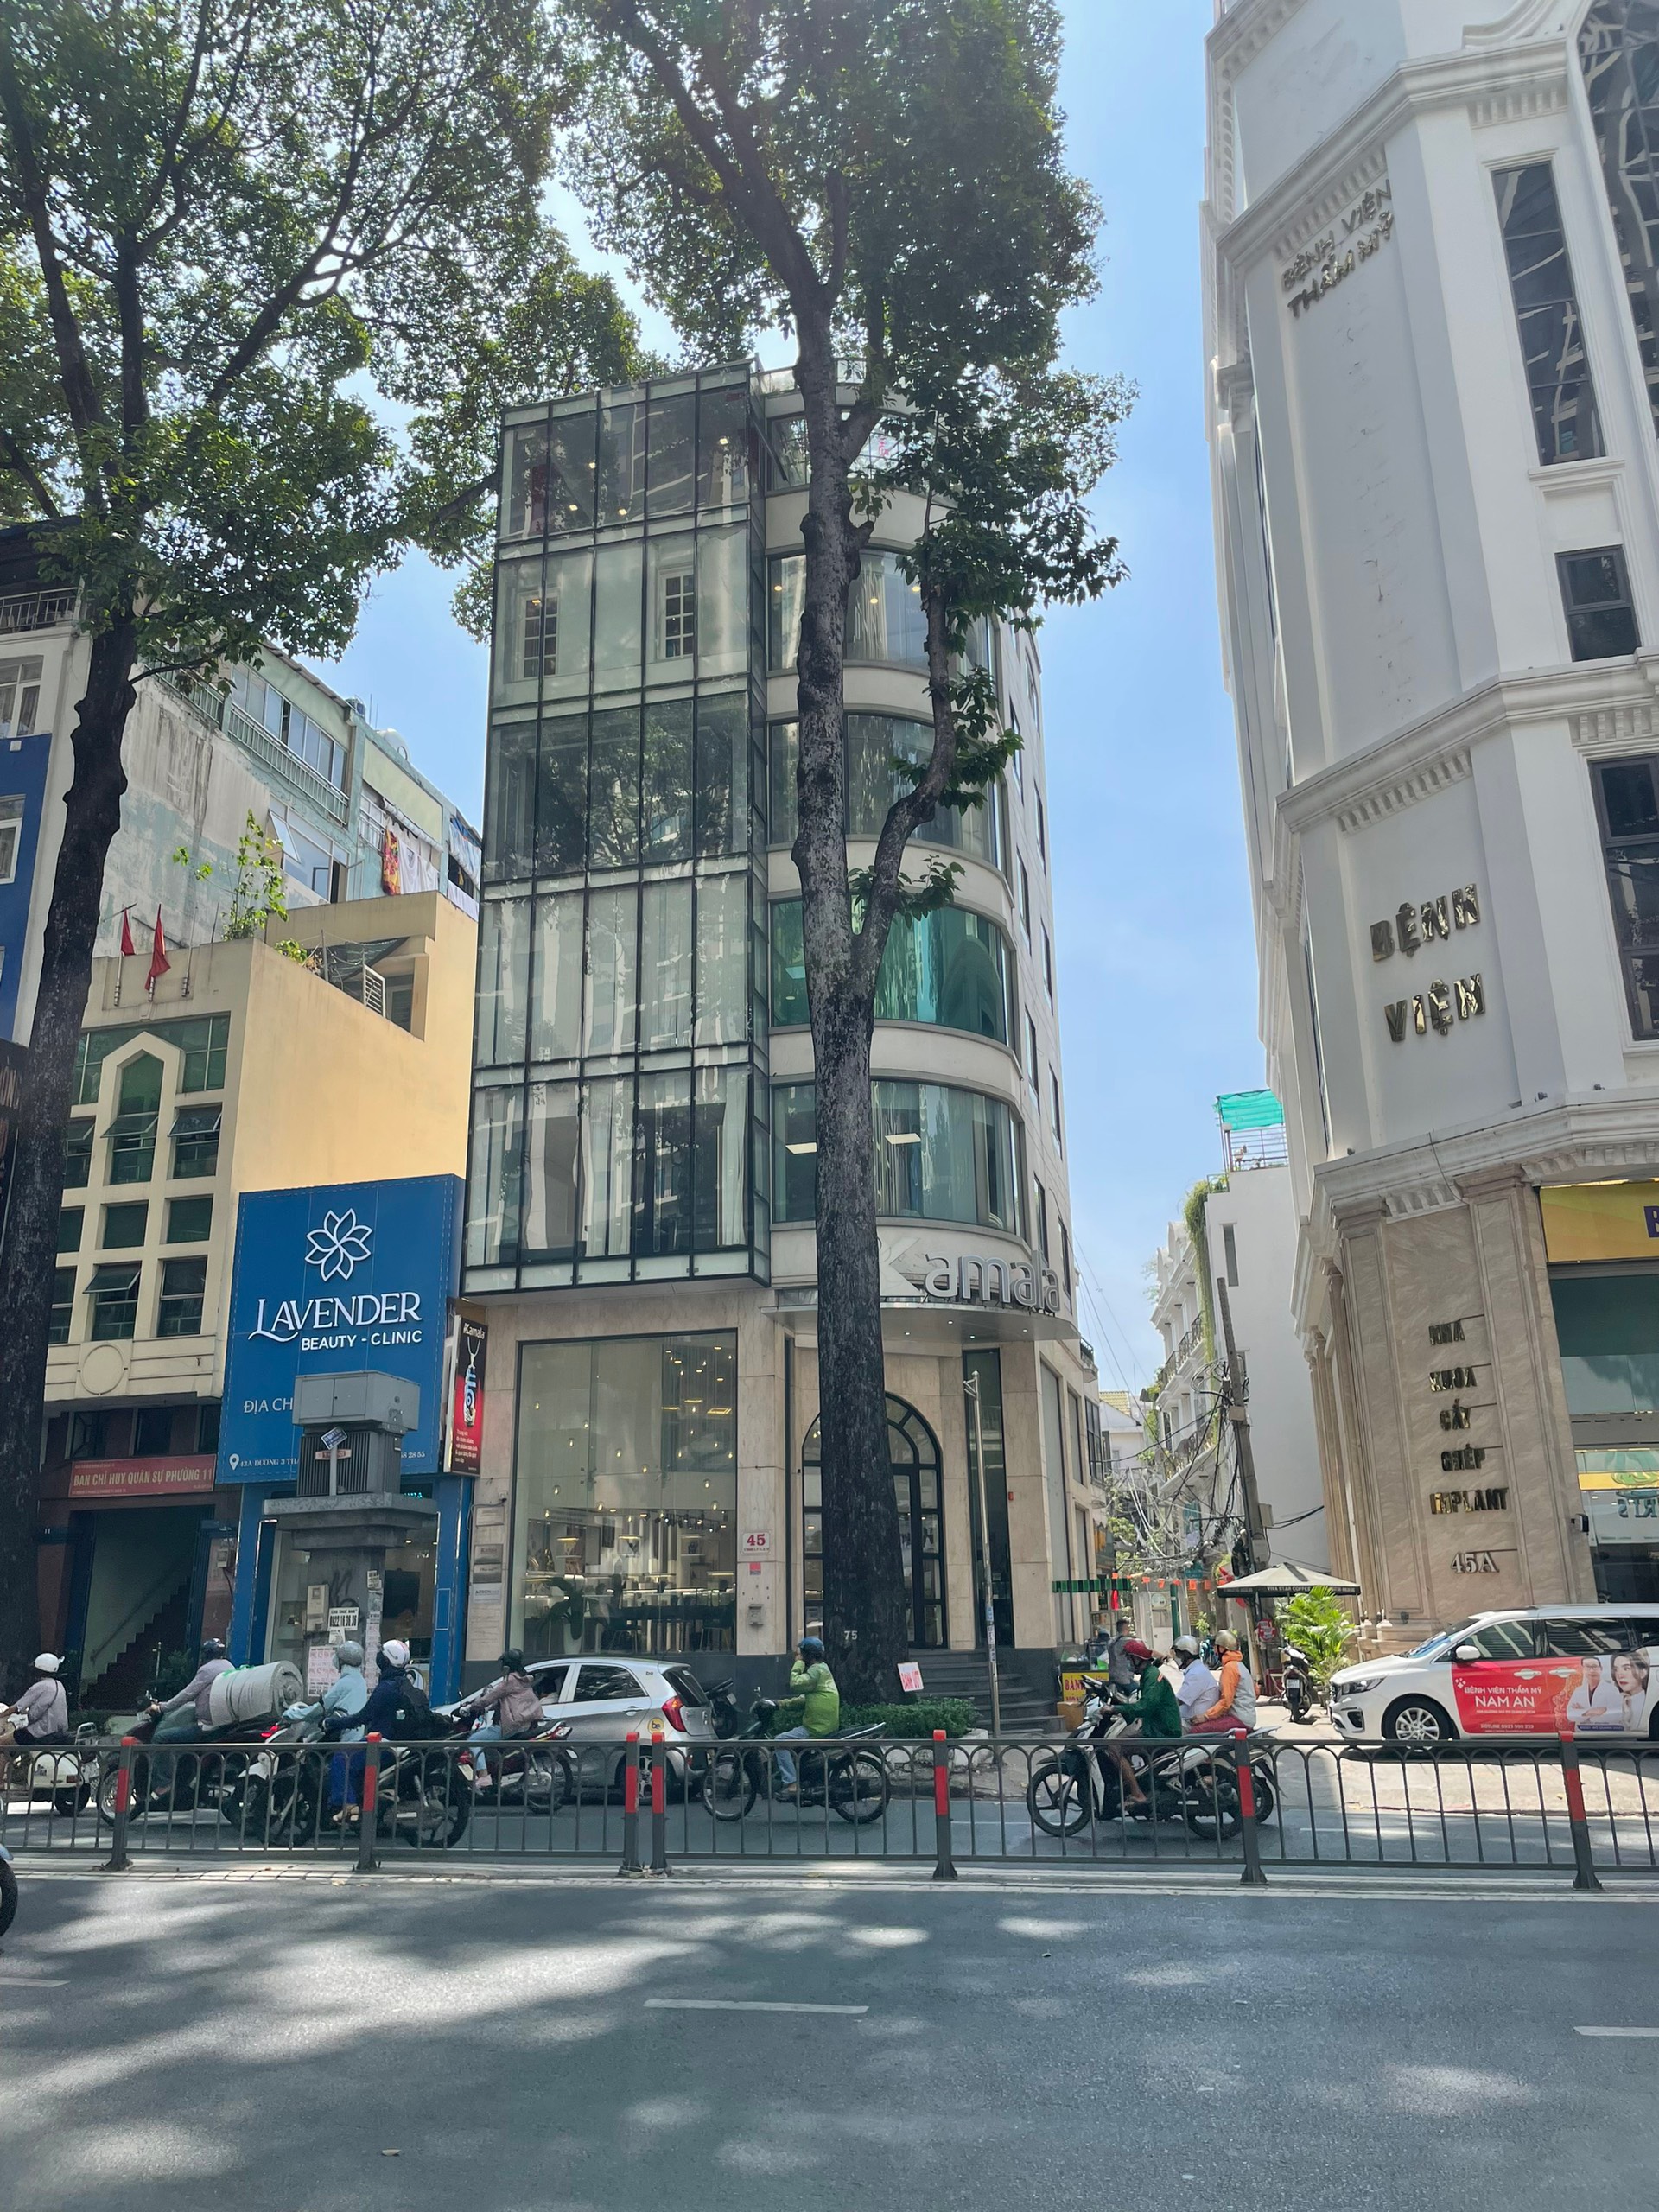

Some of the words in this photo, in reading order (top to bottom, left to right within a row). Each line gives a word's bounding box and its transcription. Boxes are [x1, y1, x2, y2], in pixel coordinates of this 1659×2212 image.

[1341, 178, 1392, 234] VIỆN
[1370, 883, 1480, 962] BỆNH
[1384, 973, 1485, 1042] VIỆN
[248, 1291, 422, 1342] LAVENDER
[302, 1335, 357, 1351] BEAUTY
[371, 1330, 423, 1345] CLINIC
[463, 1322, 485, 1339] Kamala
[1429, 1366, 1477, 1392] KHOA
[244, 1400, 269, 1415] ĐỊA
[74, 1475, 91, 1486] BAN
[92, 1471, 107, 1485] CHỈ
[109, 1473, 126, 1484] HUY
[128, 1470, 149, 1484] QUÂN
[152, 1470, 163, 1485] SỰ
[166, 1467, 200, 1482] PHƯỜNG
[202, 1468, 212, 1480] 11
[1429, 1487, 1509, 1514] IMPLANT
[747, 1534, 766, 1546] 45
[1450, 1552, 1500, 1573] 45A
[844, 1630, 858, 1640] 75
[1465, 1685, 1486, 1694] BỆNH
[1487, 1685, 1505, 1694] VIỆN
[1475, 1695, 1510, 1707] NAM
[1512, 1695, 1535, 1707] AN
[652, 1720, 661, 1729] be
